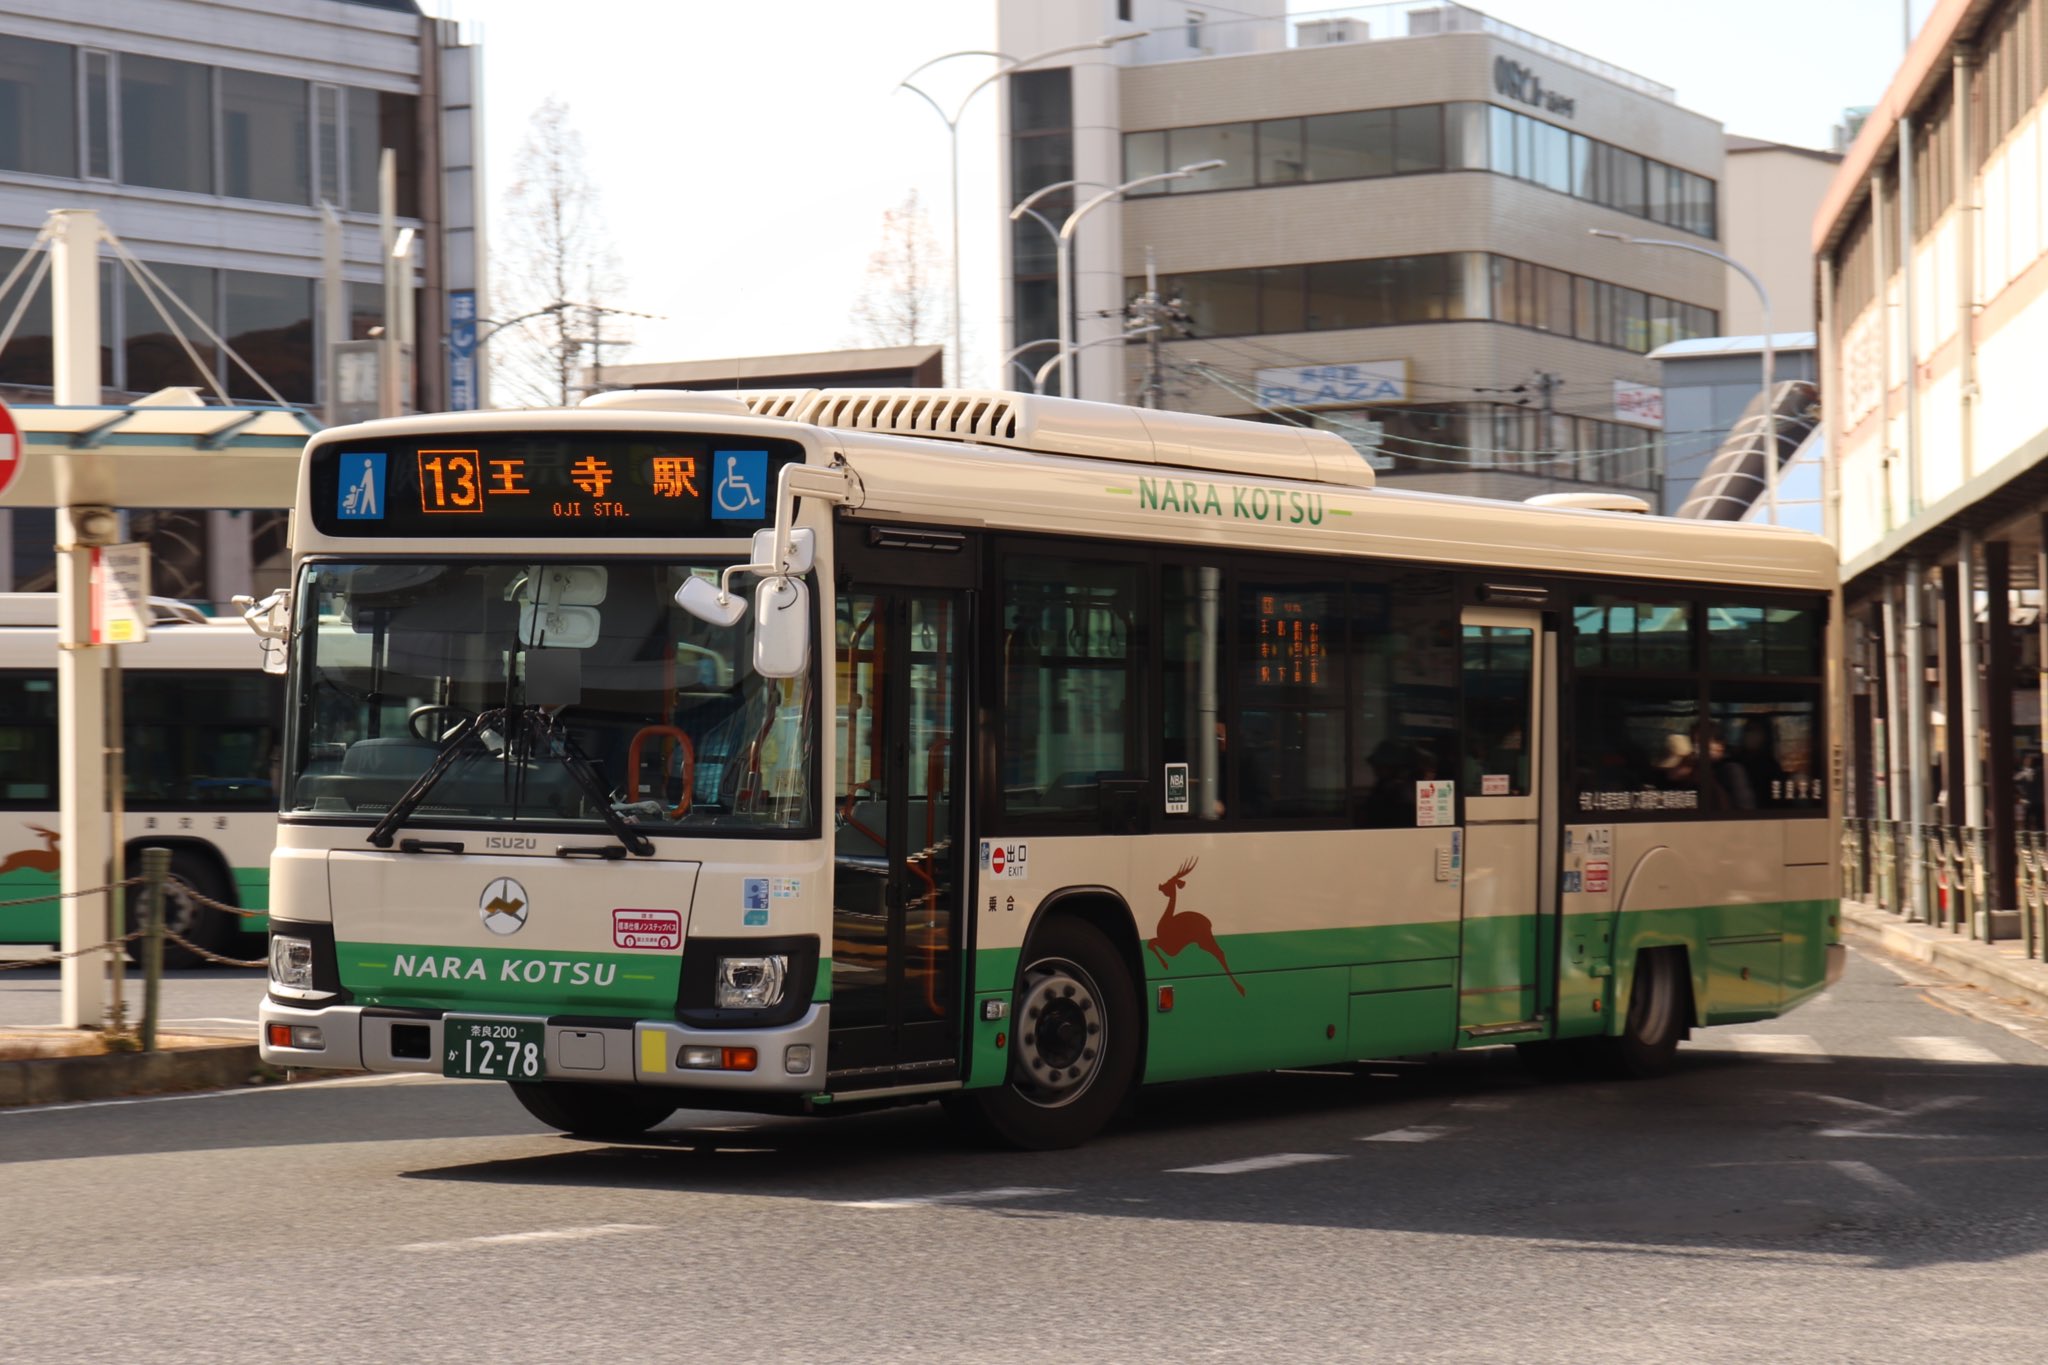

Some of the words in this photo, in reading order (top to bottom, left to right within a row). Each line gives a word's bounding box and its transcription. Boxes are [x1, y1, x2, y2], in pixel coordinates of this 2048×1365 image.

[1261, 380, 1401, 407] PLAZA
[425, 457, 476, 506] 13
[553, 502, 581, 517] OJI
[593, 502, 631, 517] STA.
[1138, 476, 1222, 516] NARA
[1232, 486, 1324, 526] KOTSU
[486, 837, 537, 849] ISUZU
[1006, 844, 1027, 863] 出口
[1008, 866, 1023, 877] EXIT
[393, 954, 487, 980] NARA
[500, 959, 617, 986] KOTSU
[448, 1049, 459, 1061] か
[465, 1039, 539, 1077] 12-78
